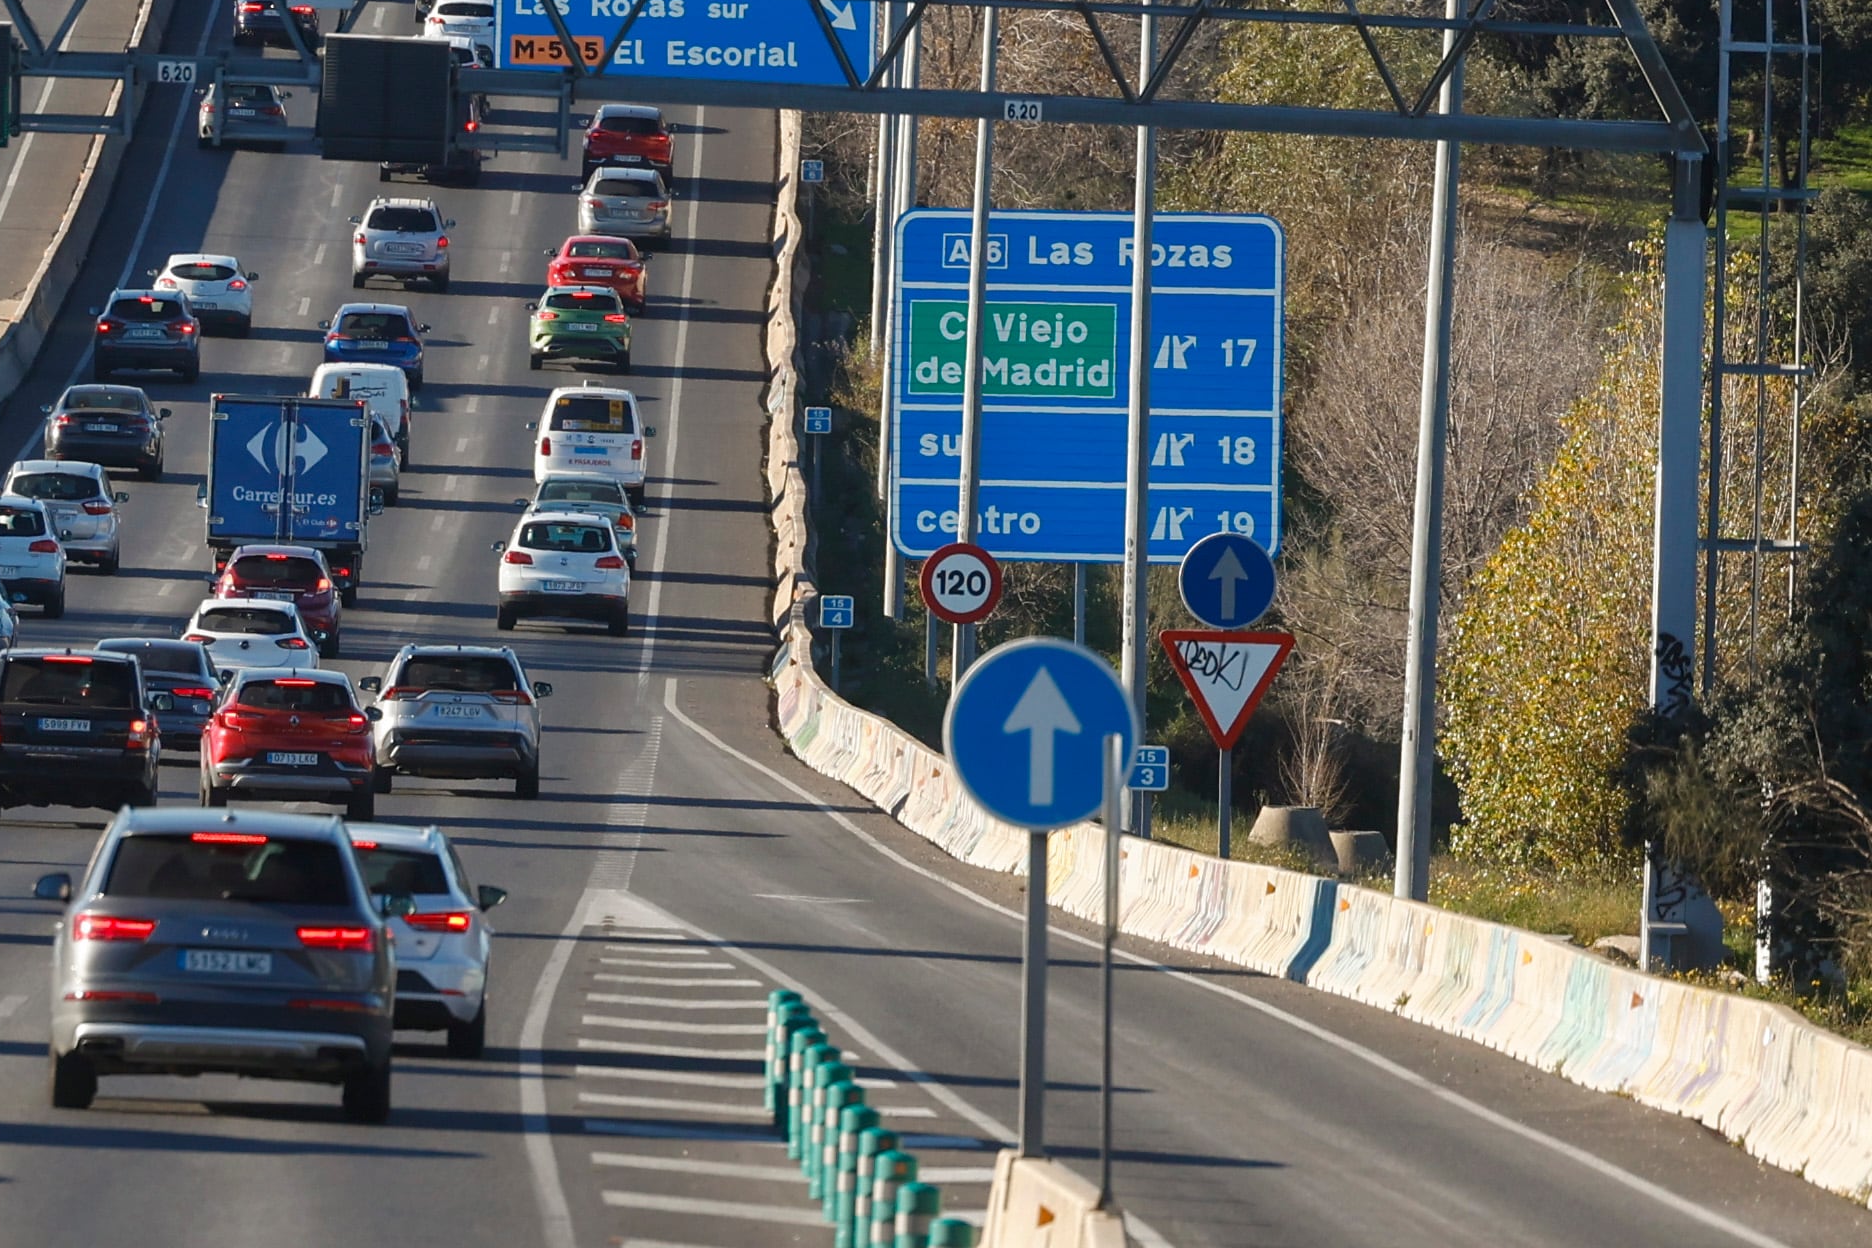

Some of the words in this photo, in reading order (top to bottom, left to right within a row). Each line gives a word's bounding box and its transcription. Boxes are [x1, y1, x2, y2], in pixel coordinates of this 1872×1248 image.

[707, 2, 748, 19] sur
[614, 39, 644, 65] El
[667, 41, 798, 68] Escorial
[162, 65, 192, 81] 6,20
[1008, 103, 1037, 120] 6,20
[948, 239, 1002, 263] A6
[1028, 236, 1094, 266] Las
[993, 312, 1088, 348] Viejo
[1220, 339, 1257, 367] 17
[915, 356, 963, 384] de
[982, 357, 1110, 387] Madrid
[814, 421, 822, 430] 5
[919, 433, 962, 456] su
[1218, 436, 1256, 464] 18
[233, 486, 337, 505] Carrefour.es
[916, 505, 1041, 534] cetro
[1218, 511, 1255, 537] 19
[936, 570, 987, 596] 120
[830, 600, 844, 608] 15
[832, 613, 842, 623] 4
[274, 753, 296, 762] 0713
[1138, 751, 1156, 762] 15
[1140, 768, 1154, 785] 3
